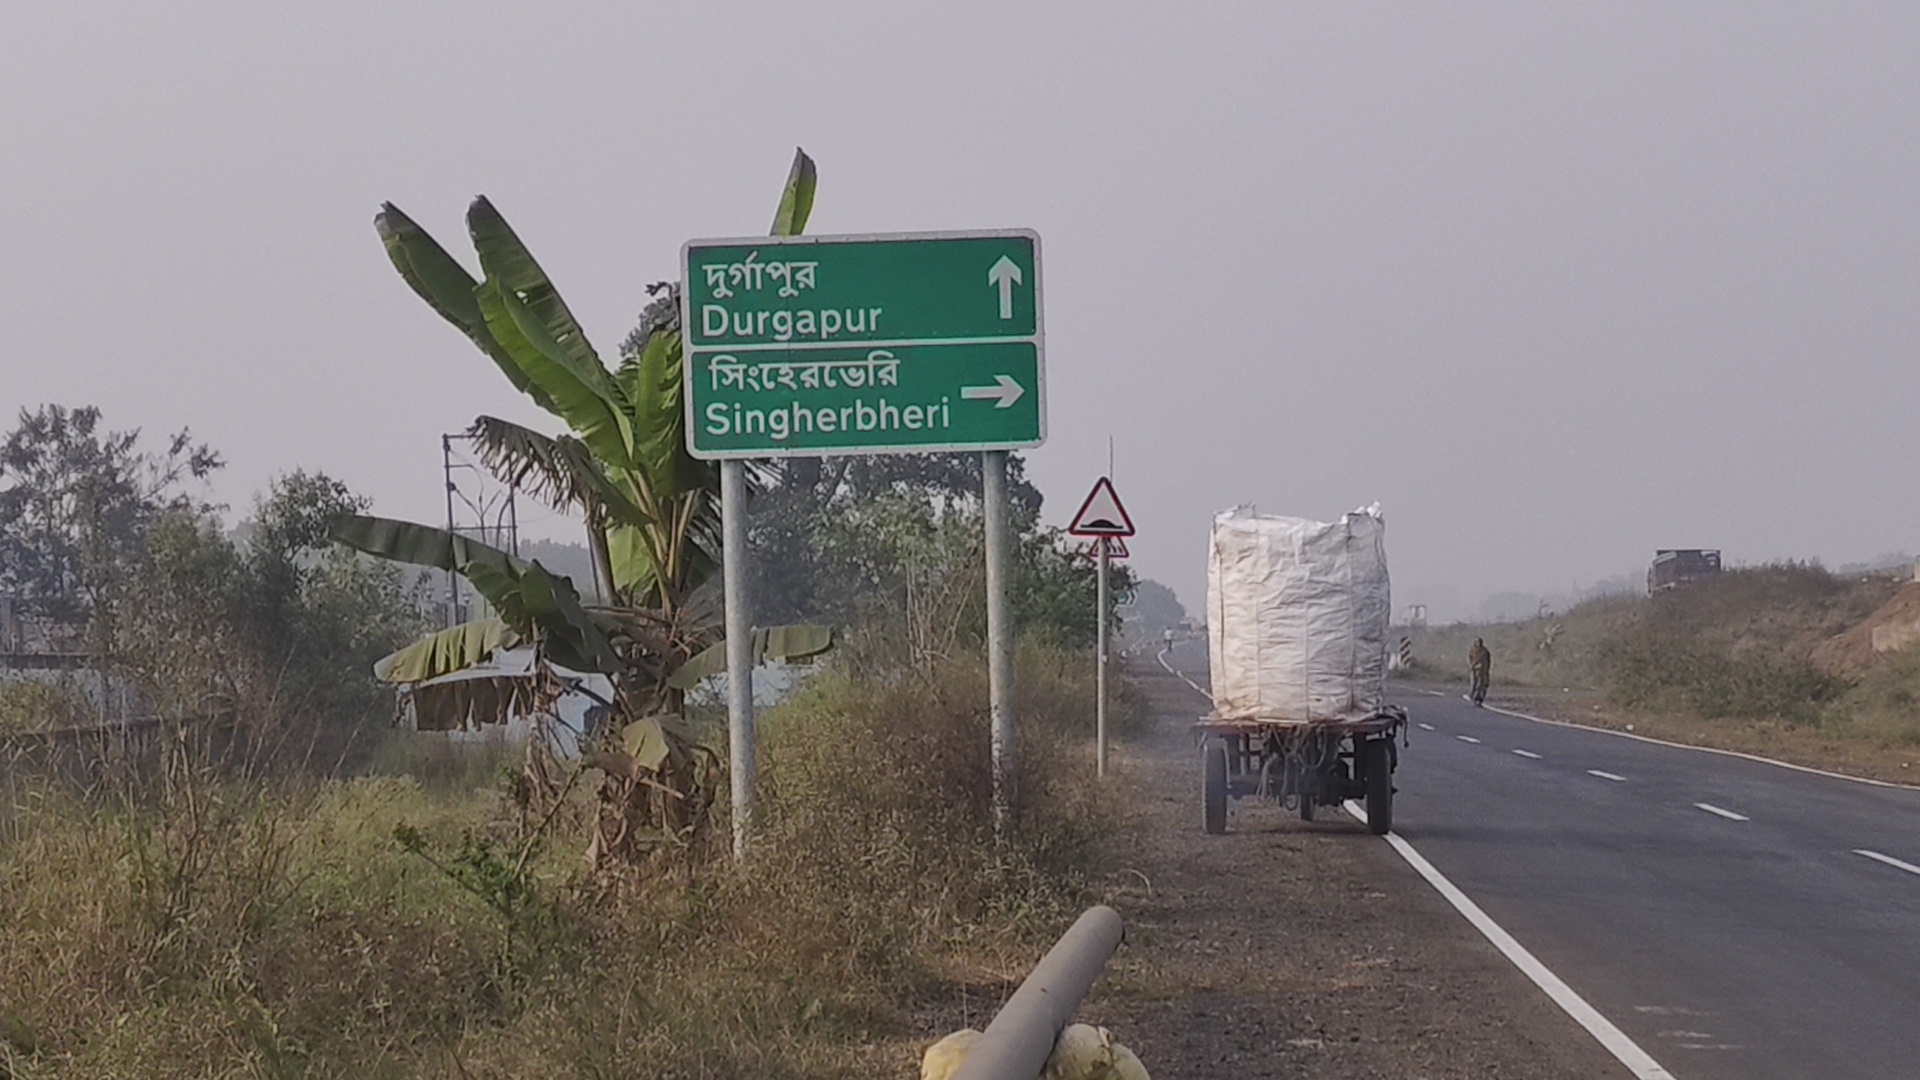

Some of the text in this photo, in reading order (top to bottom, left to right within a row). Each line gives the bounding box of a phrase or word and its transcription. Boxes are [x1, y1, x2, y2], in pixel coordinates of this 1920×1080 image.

[702, 251, 818, 299] দুর্গাপুর
[702, 304, 882, 341] Durgapur
[705, 396, 950, 440] Singherbheri
